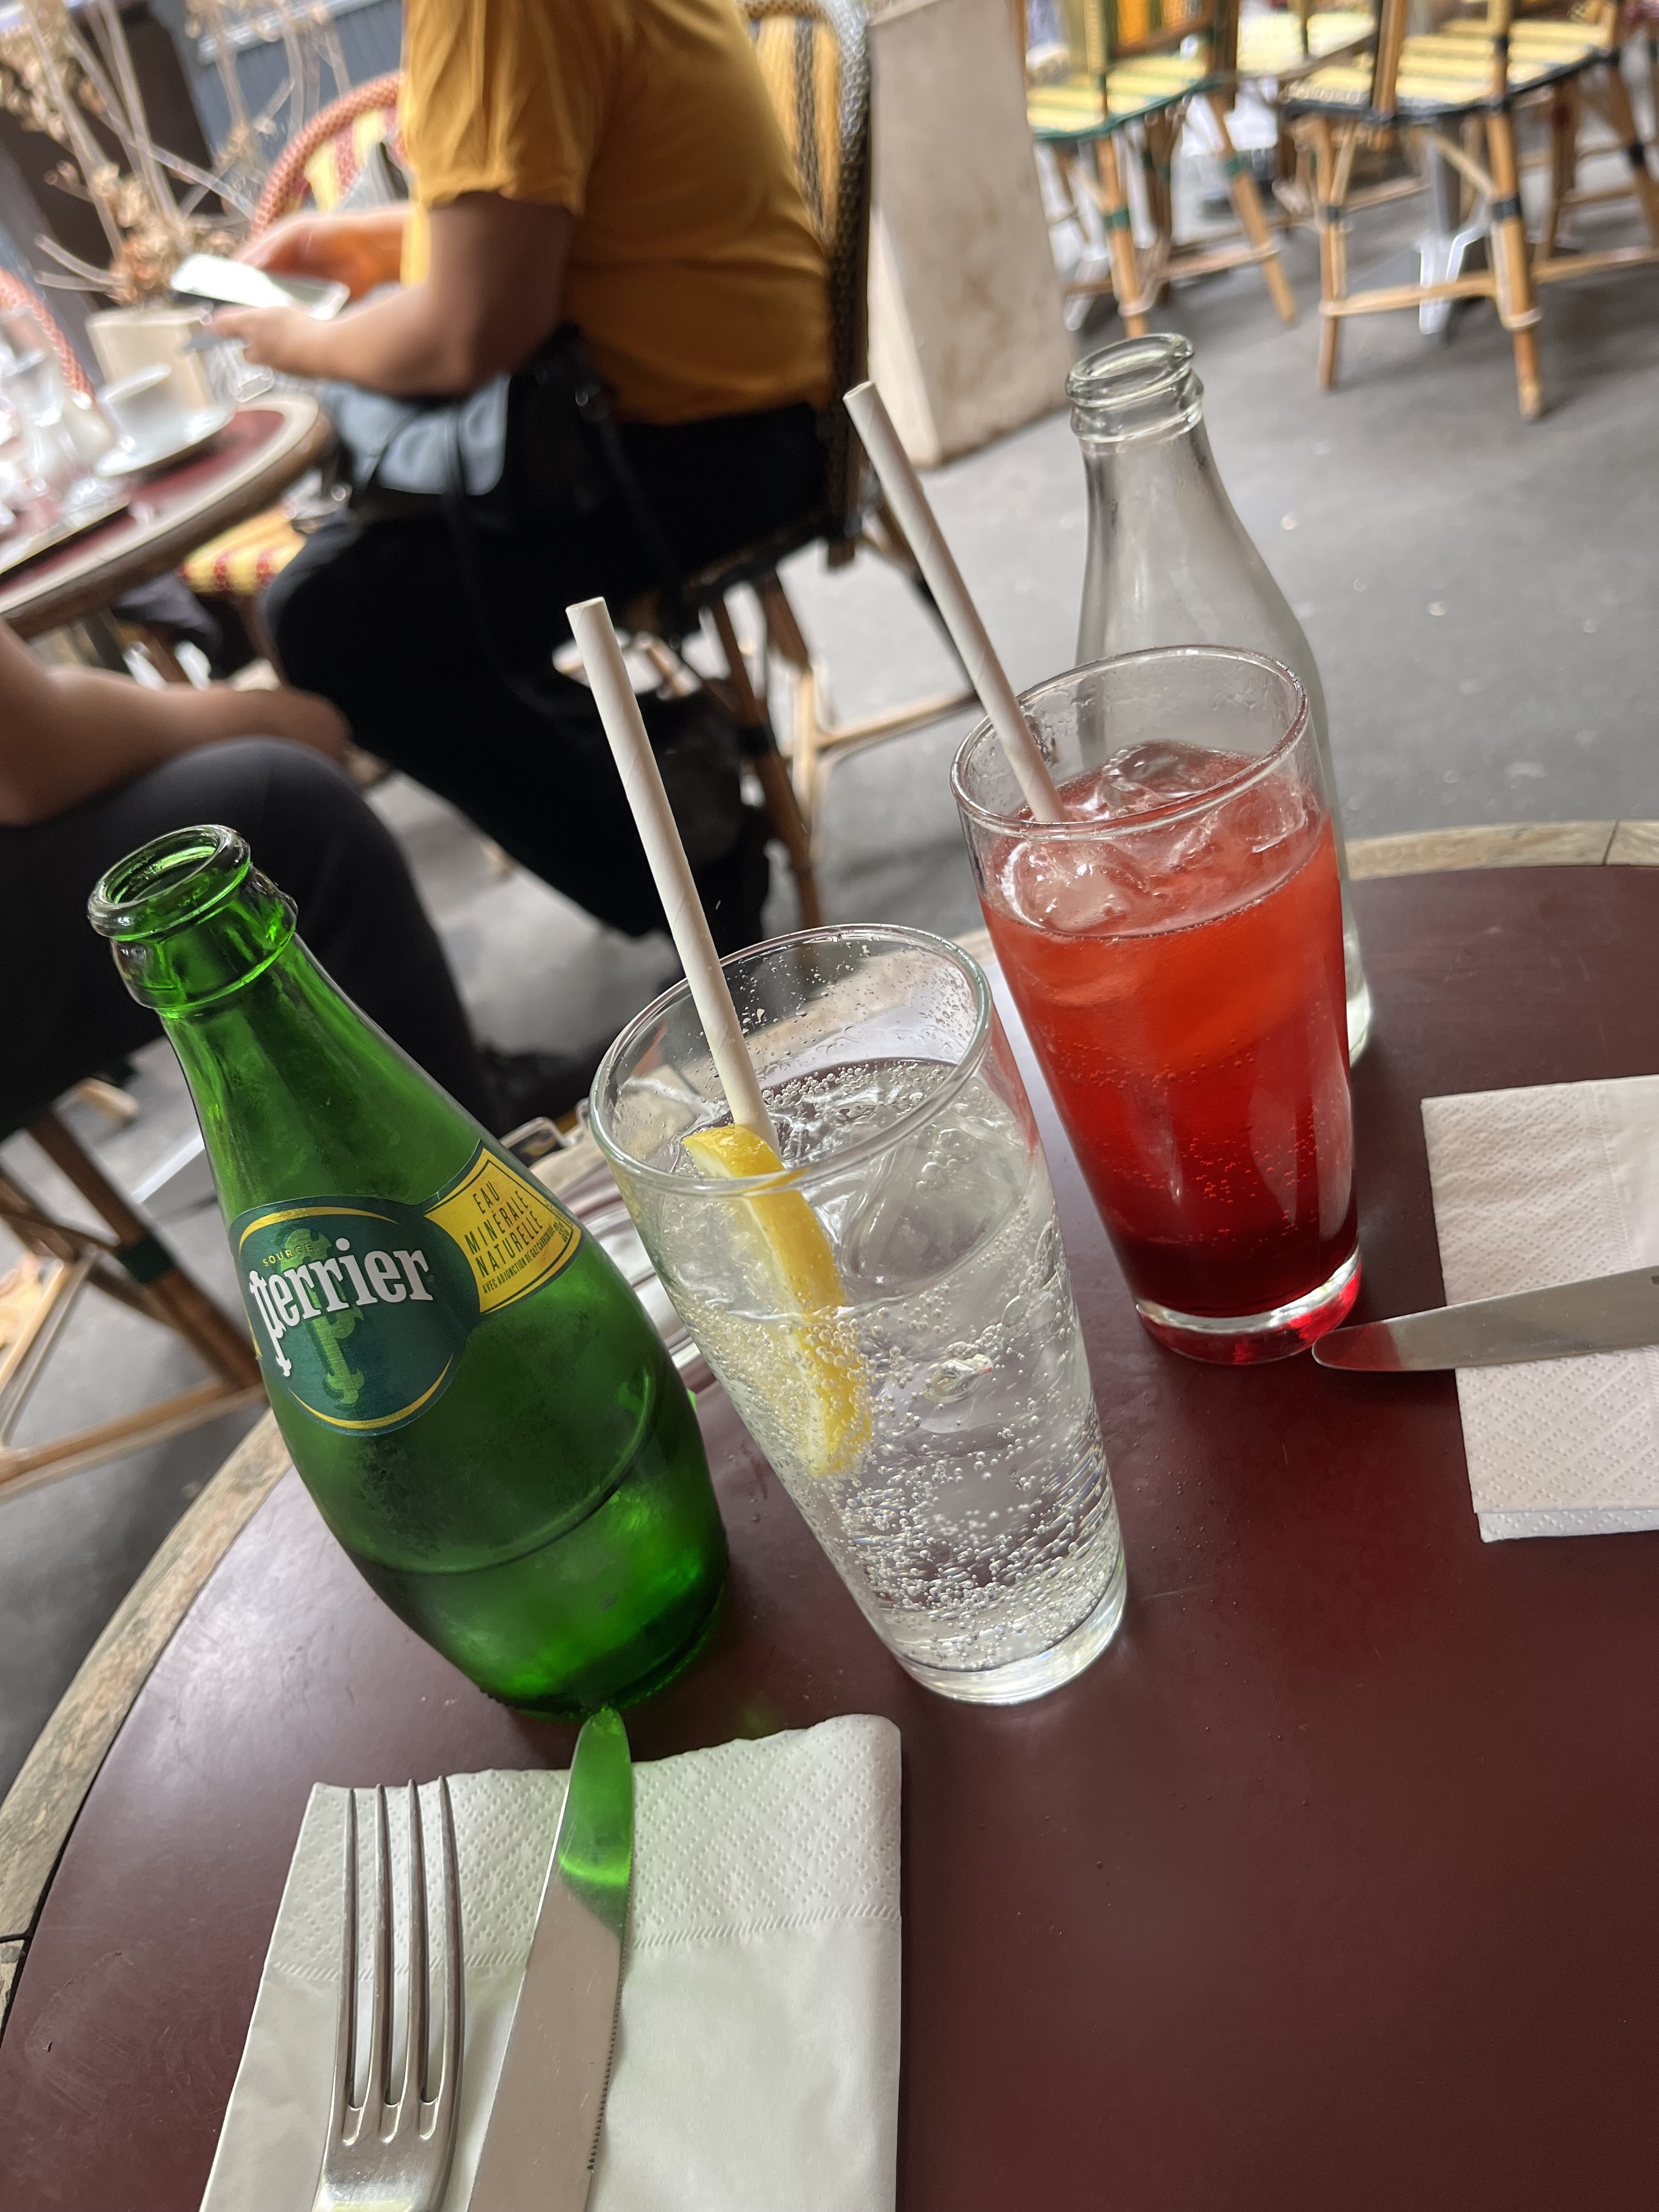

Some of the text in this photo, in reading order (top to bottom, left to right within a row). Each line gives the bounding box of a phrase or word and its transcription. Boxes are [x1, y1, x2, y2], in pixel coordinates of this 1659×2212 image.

[472, 1181, 500, 1214] EAU
[464, 1190, 528, 1255] MINÉRALE
[475, 1210, 543, 1278] NATURELLE
[262, 1243, 314, 1267] SOURCE
[482, 1278, 498, 1294] AVEC
[496, 1257, 527, 1285] ADJONCTION
[524, 1251, 533, 1263] DE
[529, 1245, 540, 1258] GAZ
